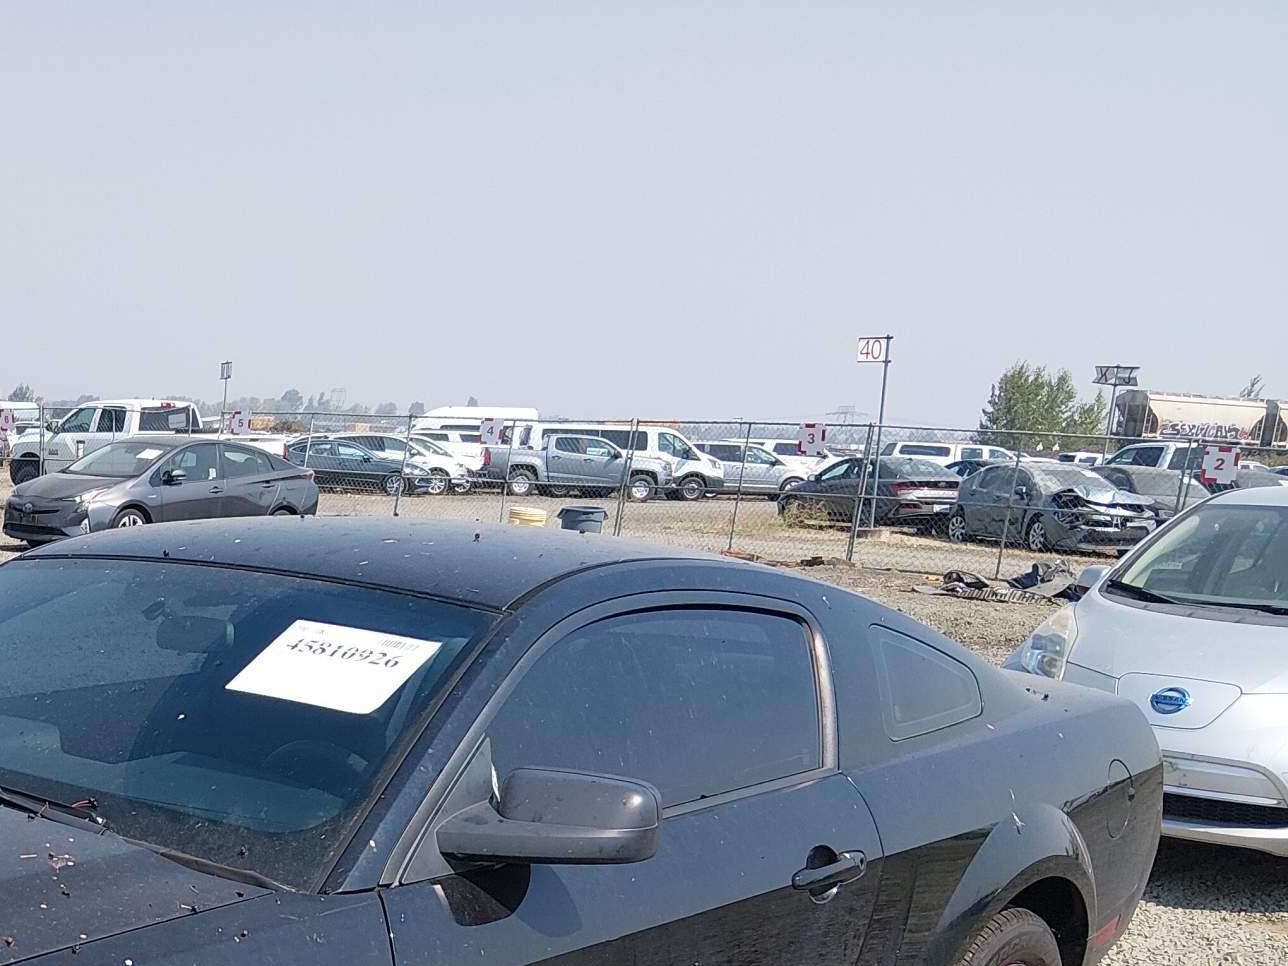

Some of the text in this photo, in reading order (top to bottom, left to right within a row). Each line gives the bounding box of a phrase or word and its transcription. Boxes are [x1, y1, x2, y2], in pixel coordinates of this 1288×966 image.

[859, 339, 882, 360] 40
[238, 418, 244, 428] 5
[487, 426, 494, 436] 4
[807, 432, 815, 444] 3
[1213, 457, 1225, 471] 2
[286, 638, 404, 668] 45810926
